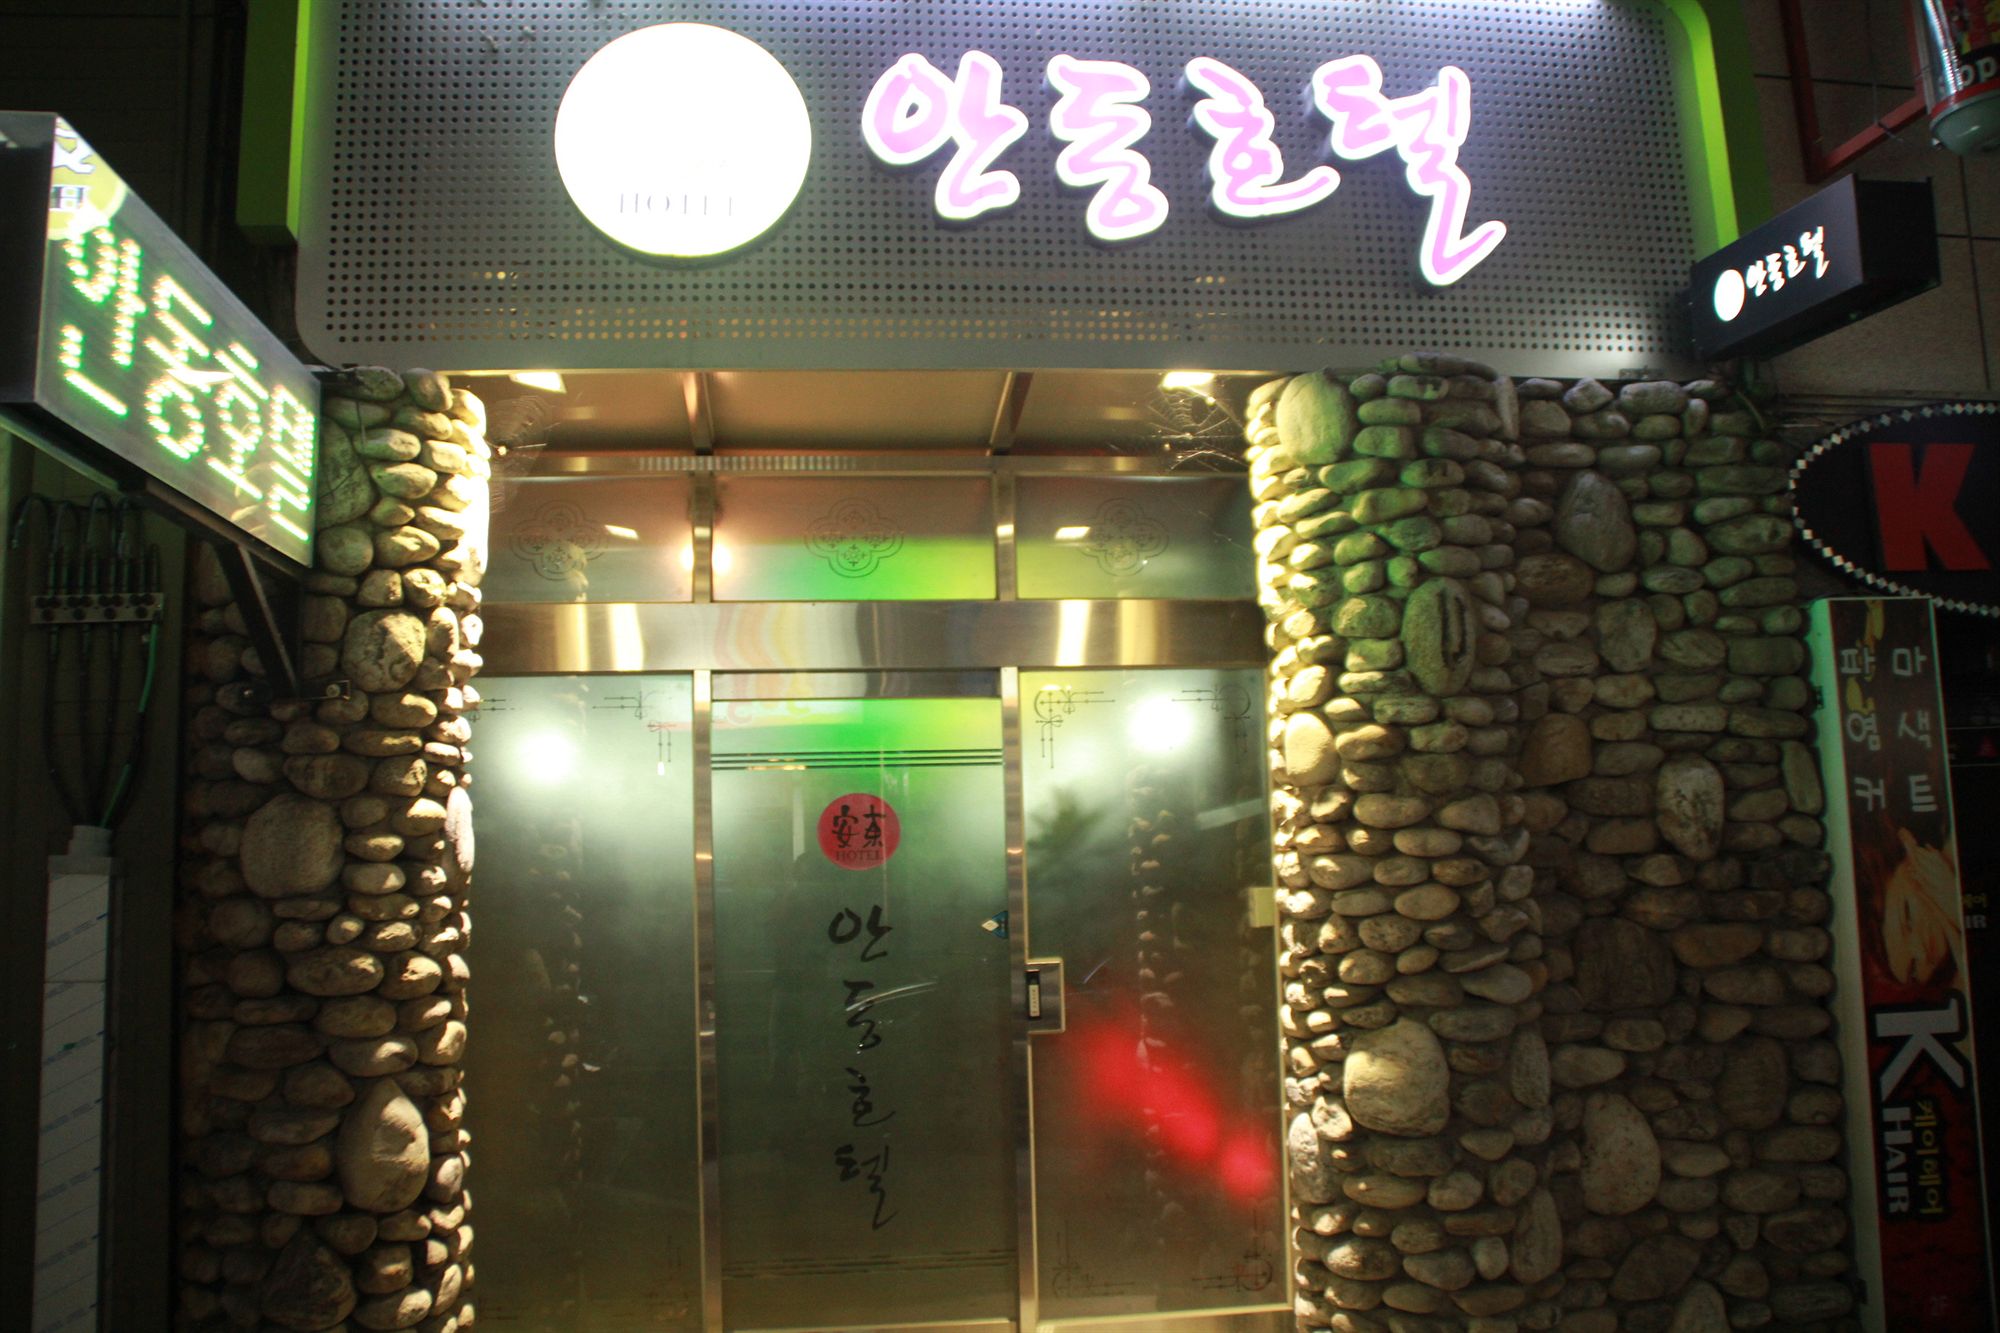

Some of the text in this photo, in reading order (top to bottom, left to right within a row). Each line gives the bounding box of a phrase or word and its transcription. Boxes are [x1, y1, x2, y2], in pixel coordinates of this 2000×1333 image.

[862, 51, 1506, 286] 안동호텔
[1745, 225, 1830, 298] 안동호텔
[58, 226, 316, 542] 안동호텔
[1868, 442, 1991, 571] K
[1840, 645, 1928, 677] 파마
[1845, 709, 1933, 752] 염색
[1853, 774, 1938, 813] 커트
[835, 849, 885, 862] HOTEL
[828, 904, 897, 1231] 안동호텔
[1881, 1106, 1914, 1215] HAIR
